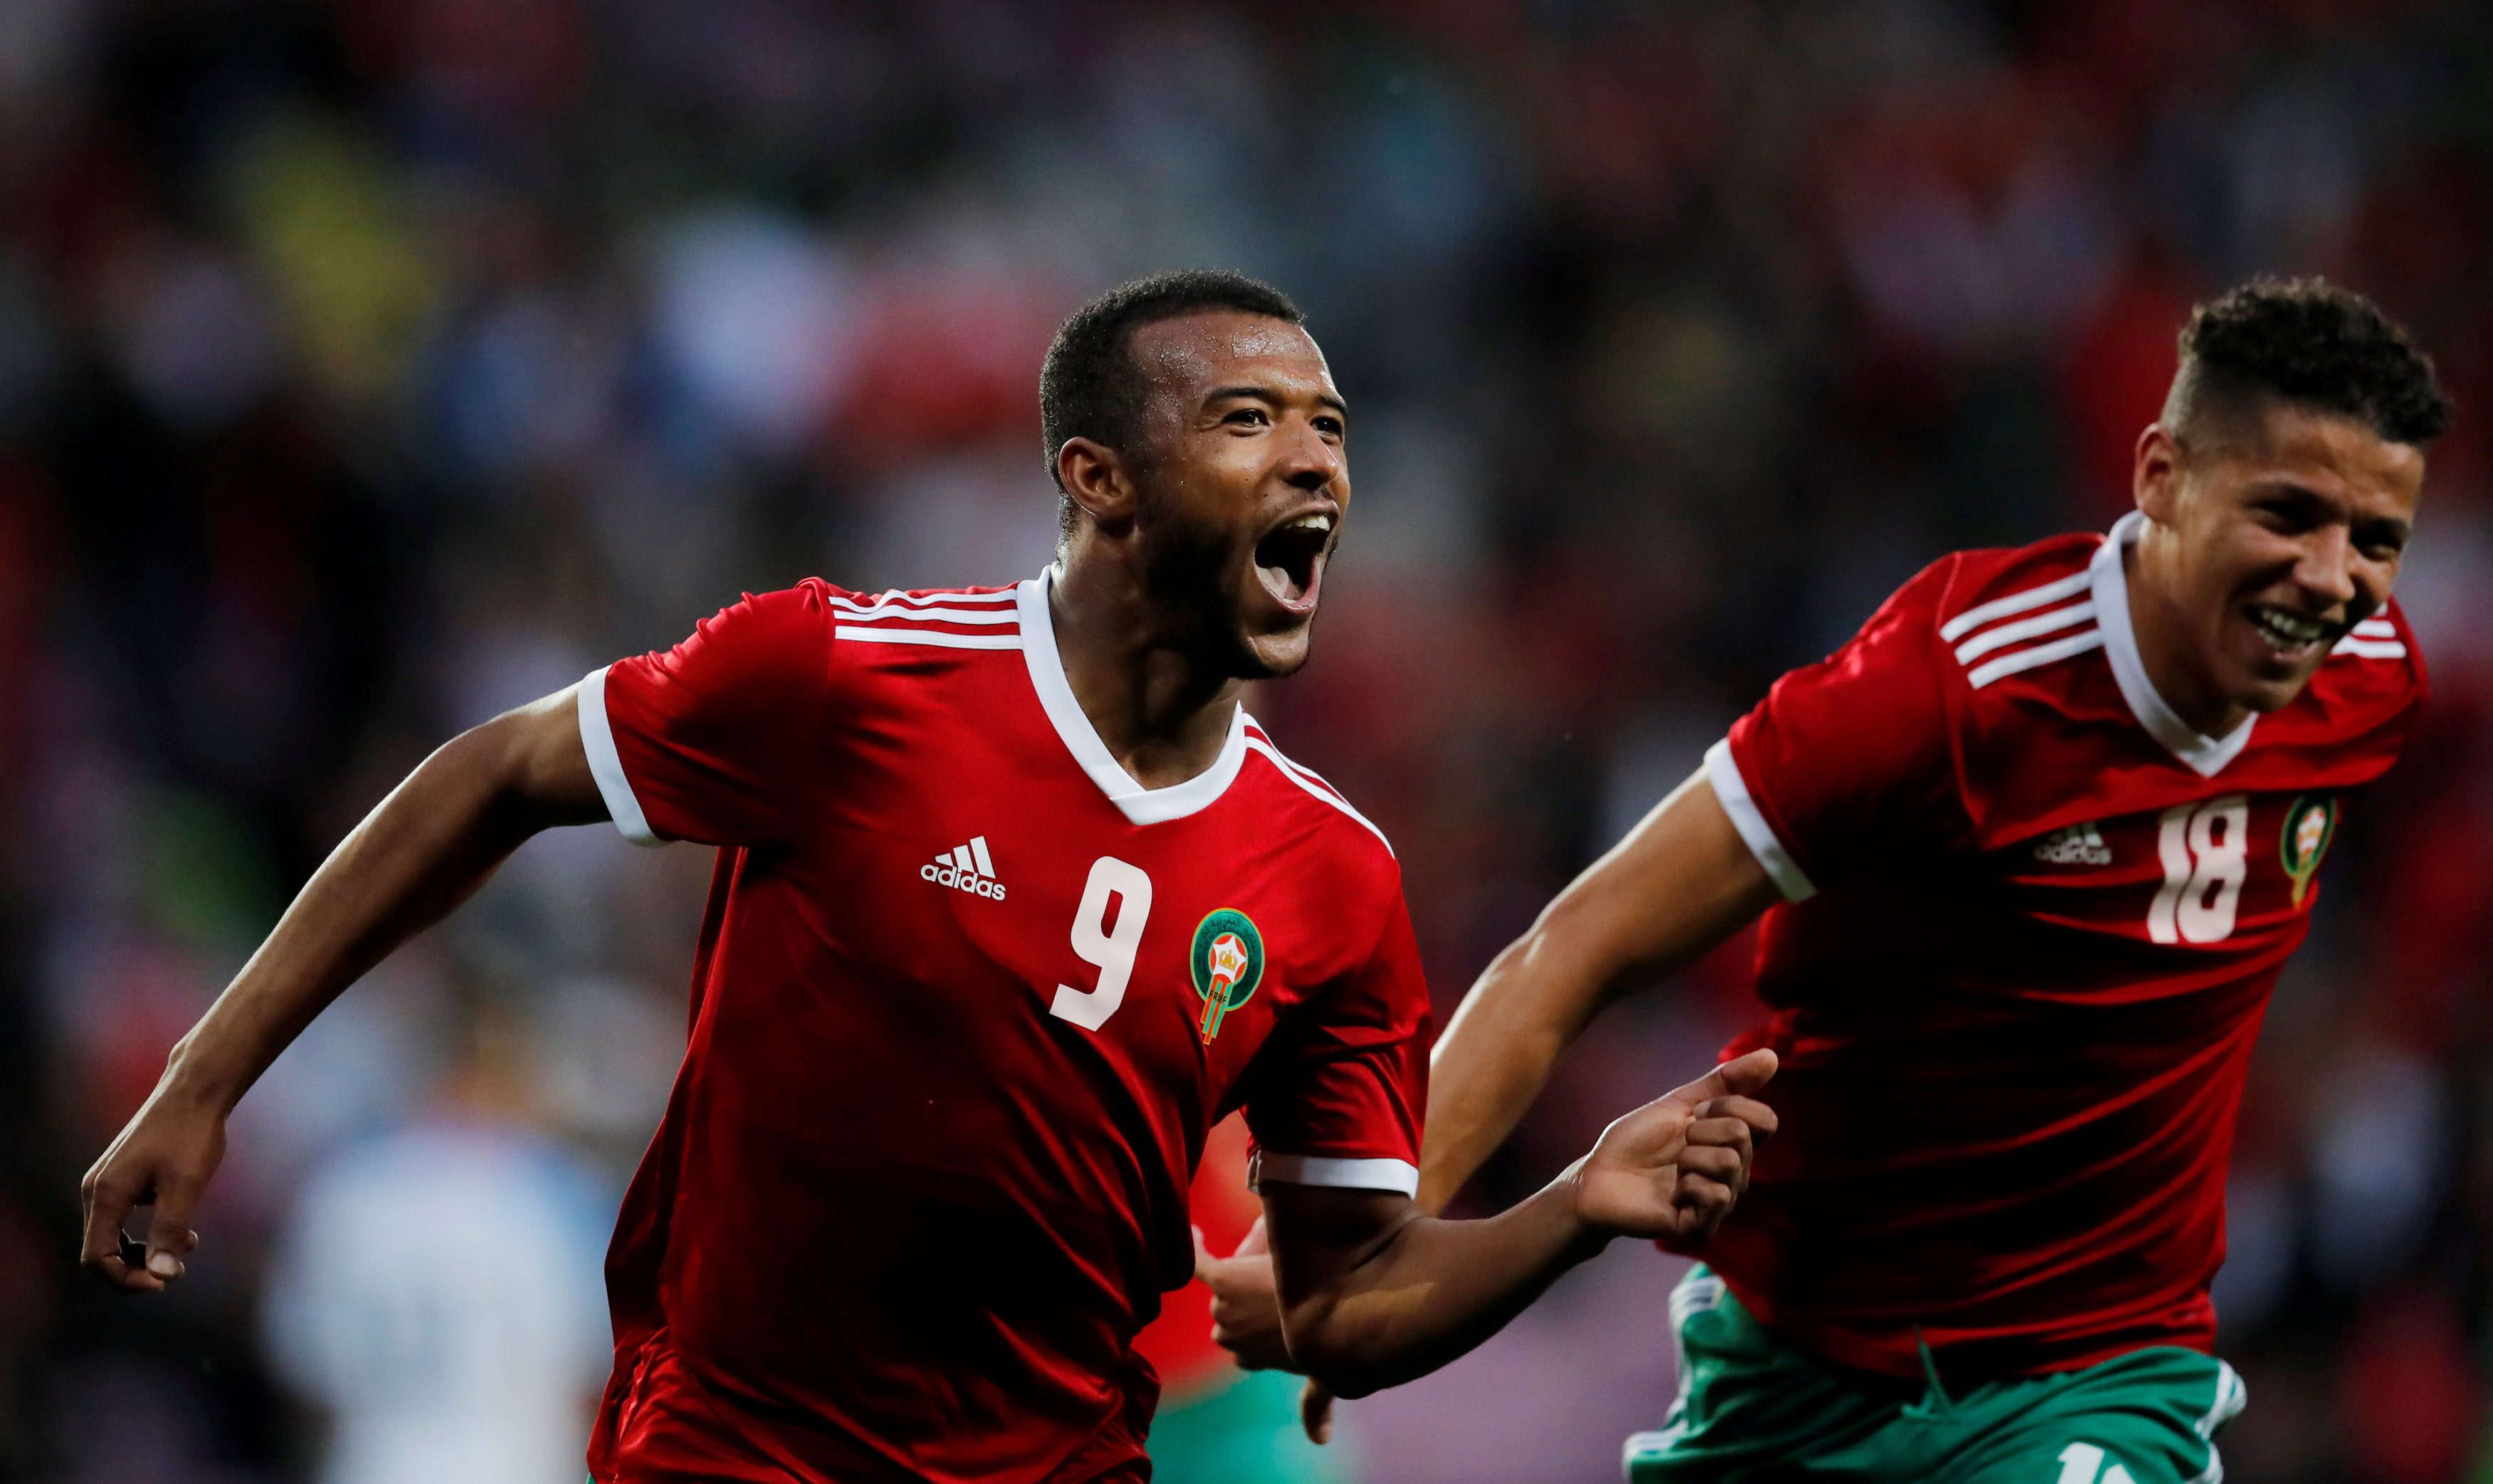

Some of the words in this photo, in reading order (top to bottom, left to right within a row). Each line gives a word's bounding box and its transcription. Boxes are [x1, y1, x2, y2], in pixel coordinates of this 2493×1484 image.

[920, 864, 1006, 901] adidas
[1049, 856, 1152, 1031] 9
[2147, 795, 2249, 944] 18
